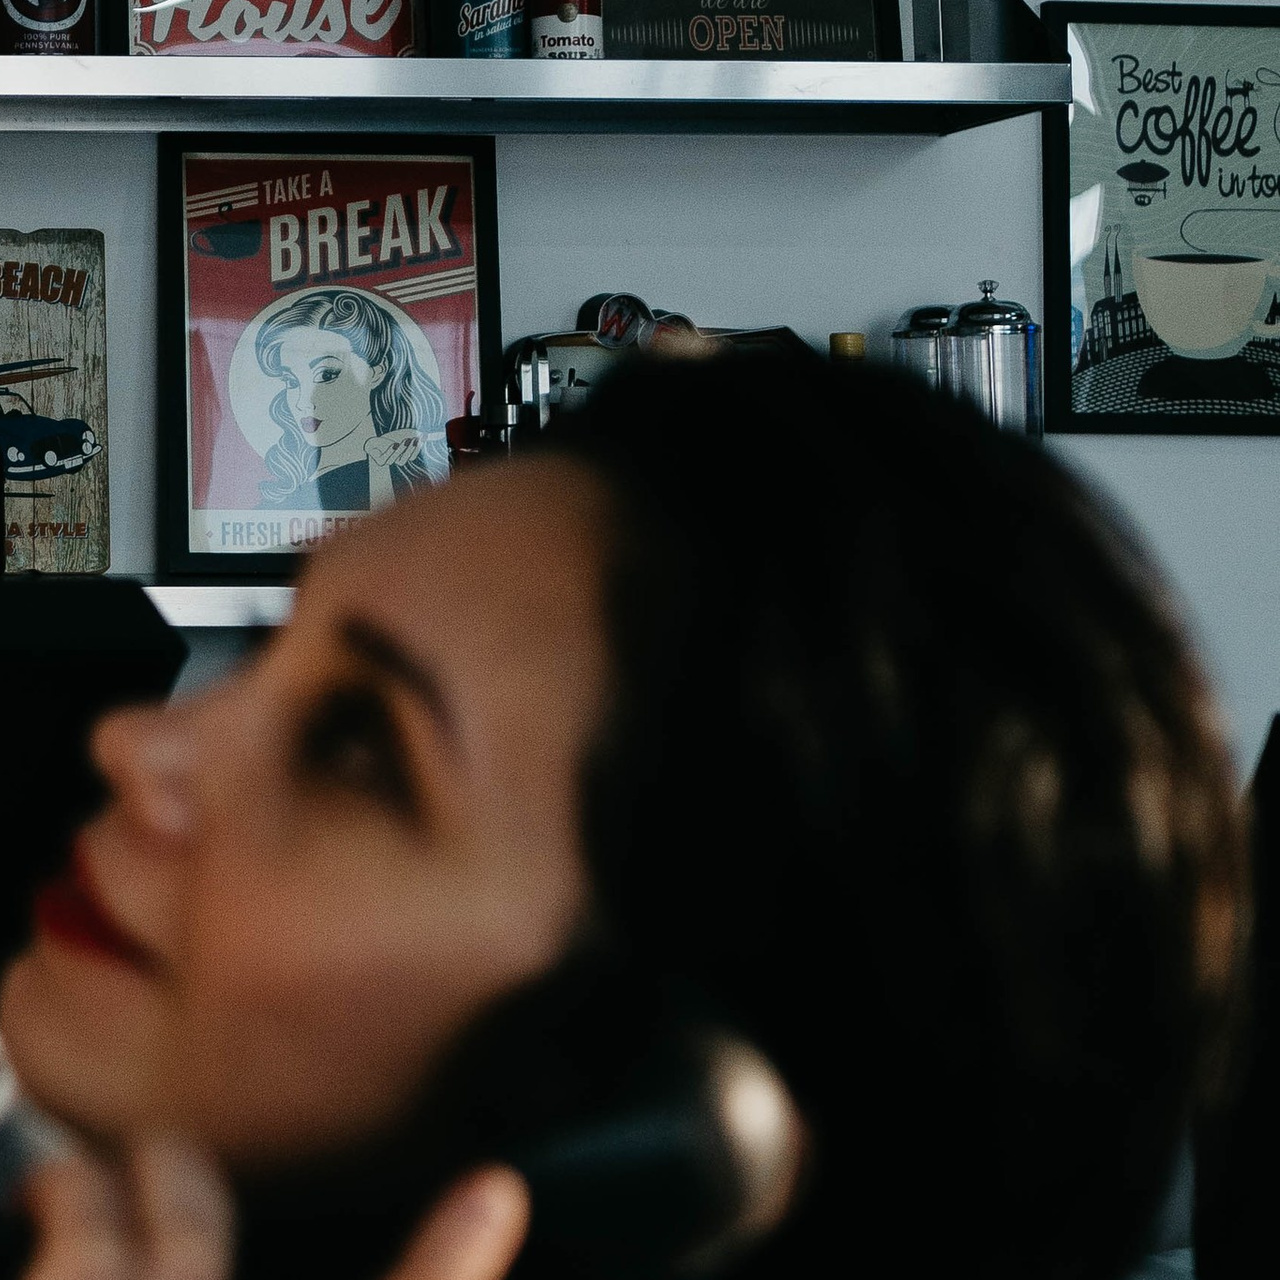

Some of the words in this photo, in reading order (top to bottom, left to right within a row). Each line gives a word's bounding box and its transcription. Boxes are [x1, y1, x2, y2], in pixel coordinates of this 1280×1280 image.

[14, 40, 80, 50] PENNSYLVANIA
[23, 33, 47, 41] 100%
[49, 33, 72, 41] PURE
[541, 33, 595, 48] Tomato
[689, 14, 785, 51] OPEN
[1111, 54, 1183, 95] Best
[1115, 75, 1261, 187] coffee
[262, 173, 312, 206] TAKE
[319, 169, 334, 197] A
[269, 184, 455, 285] BREAK
[28, 522, 89, 539] STYLE
[221, 521, 282, 547] FRESH
